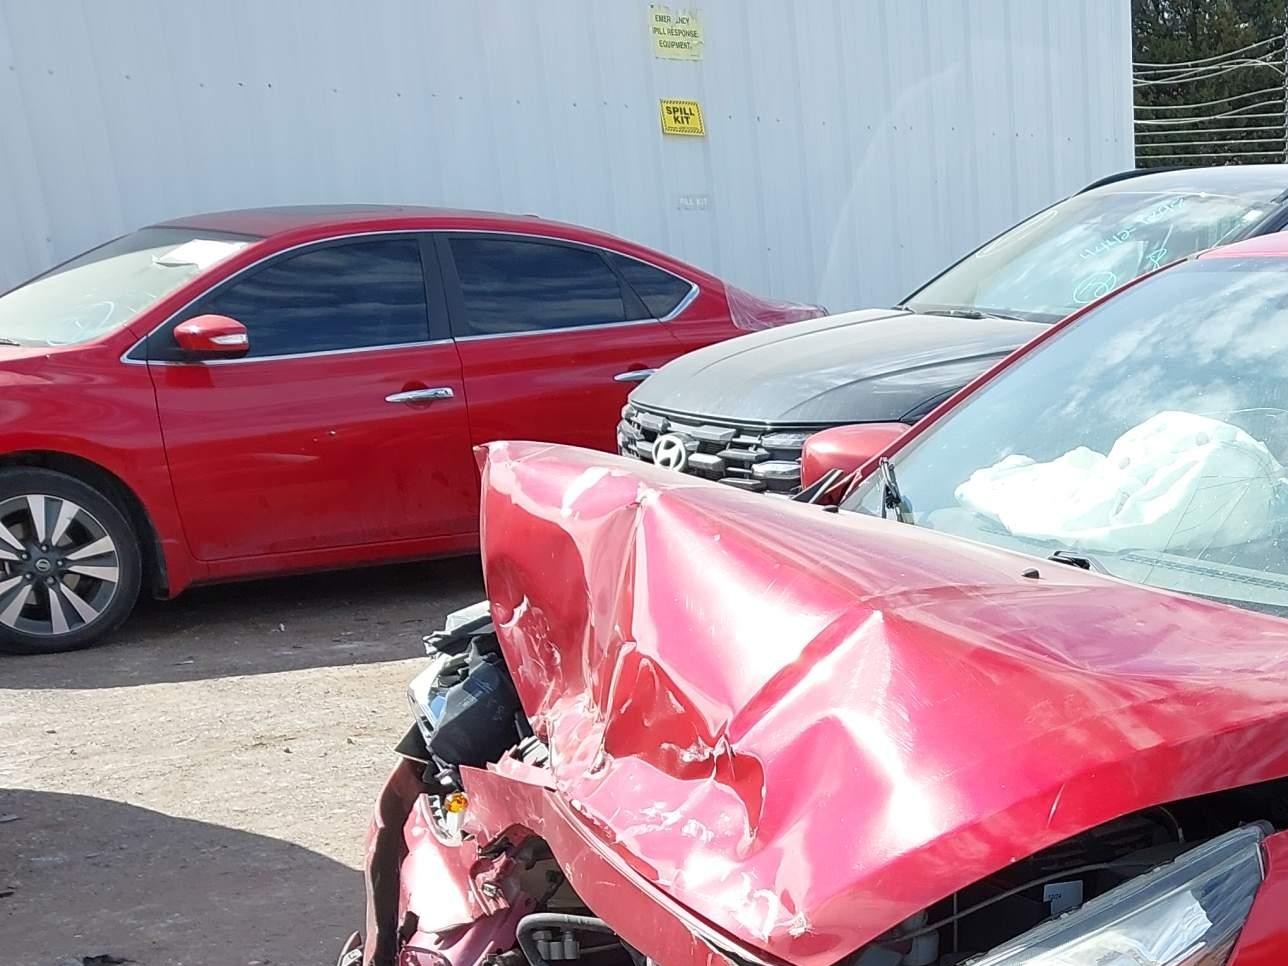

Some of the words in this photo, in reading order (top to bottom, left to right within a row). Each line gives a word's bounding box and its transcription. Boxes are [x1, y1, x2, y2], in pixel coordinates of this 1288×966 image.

[655, 14, 690, 25] EMERNCY
[666, 105, 695, 117] SPILL
[673, 115, 691, 125] KIT
